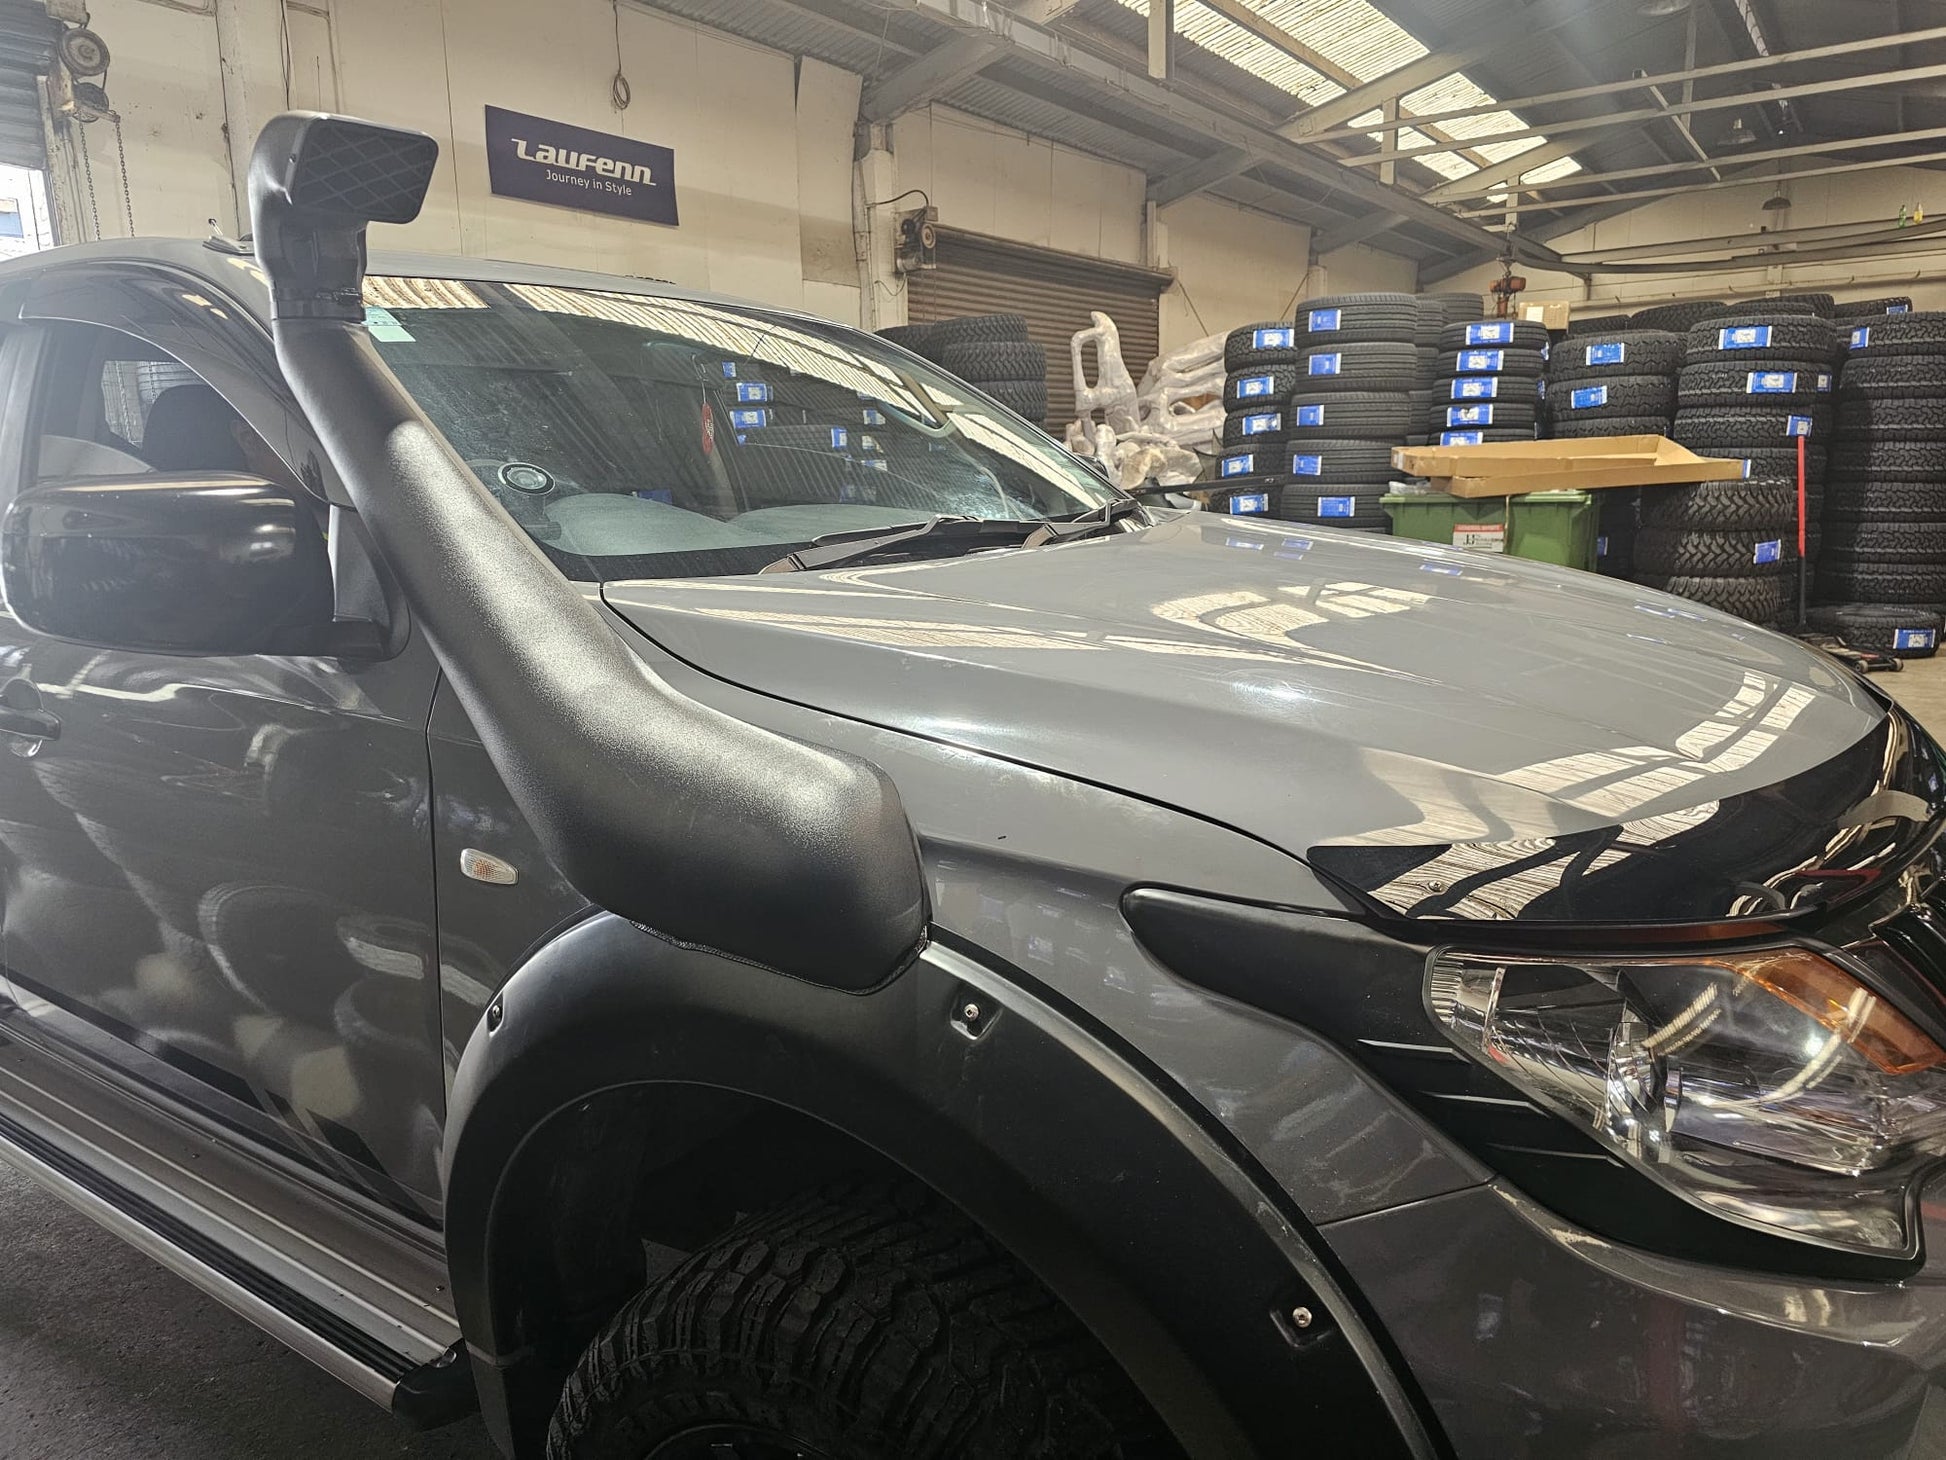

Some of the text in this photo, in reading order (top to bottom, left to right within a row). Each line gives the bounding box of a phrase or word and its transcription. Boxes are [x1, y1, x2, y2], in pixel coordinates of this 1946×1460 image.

[546, 169, 632, 196] Journey in Style
